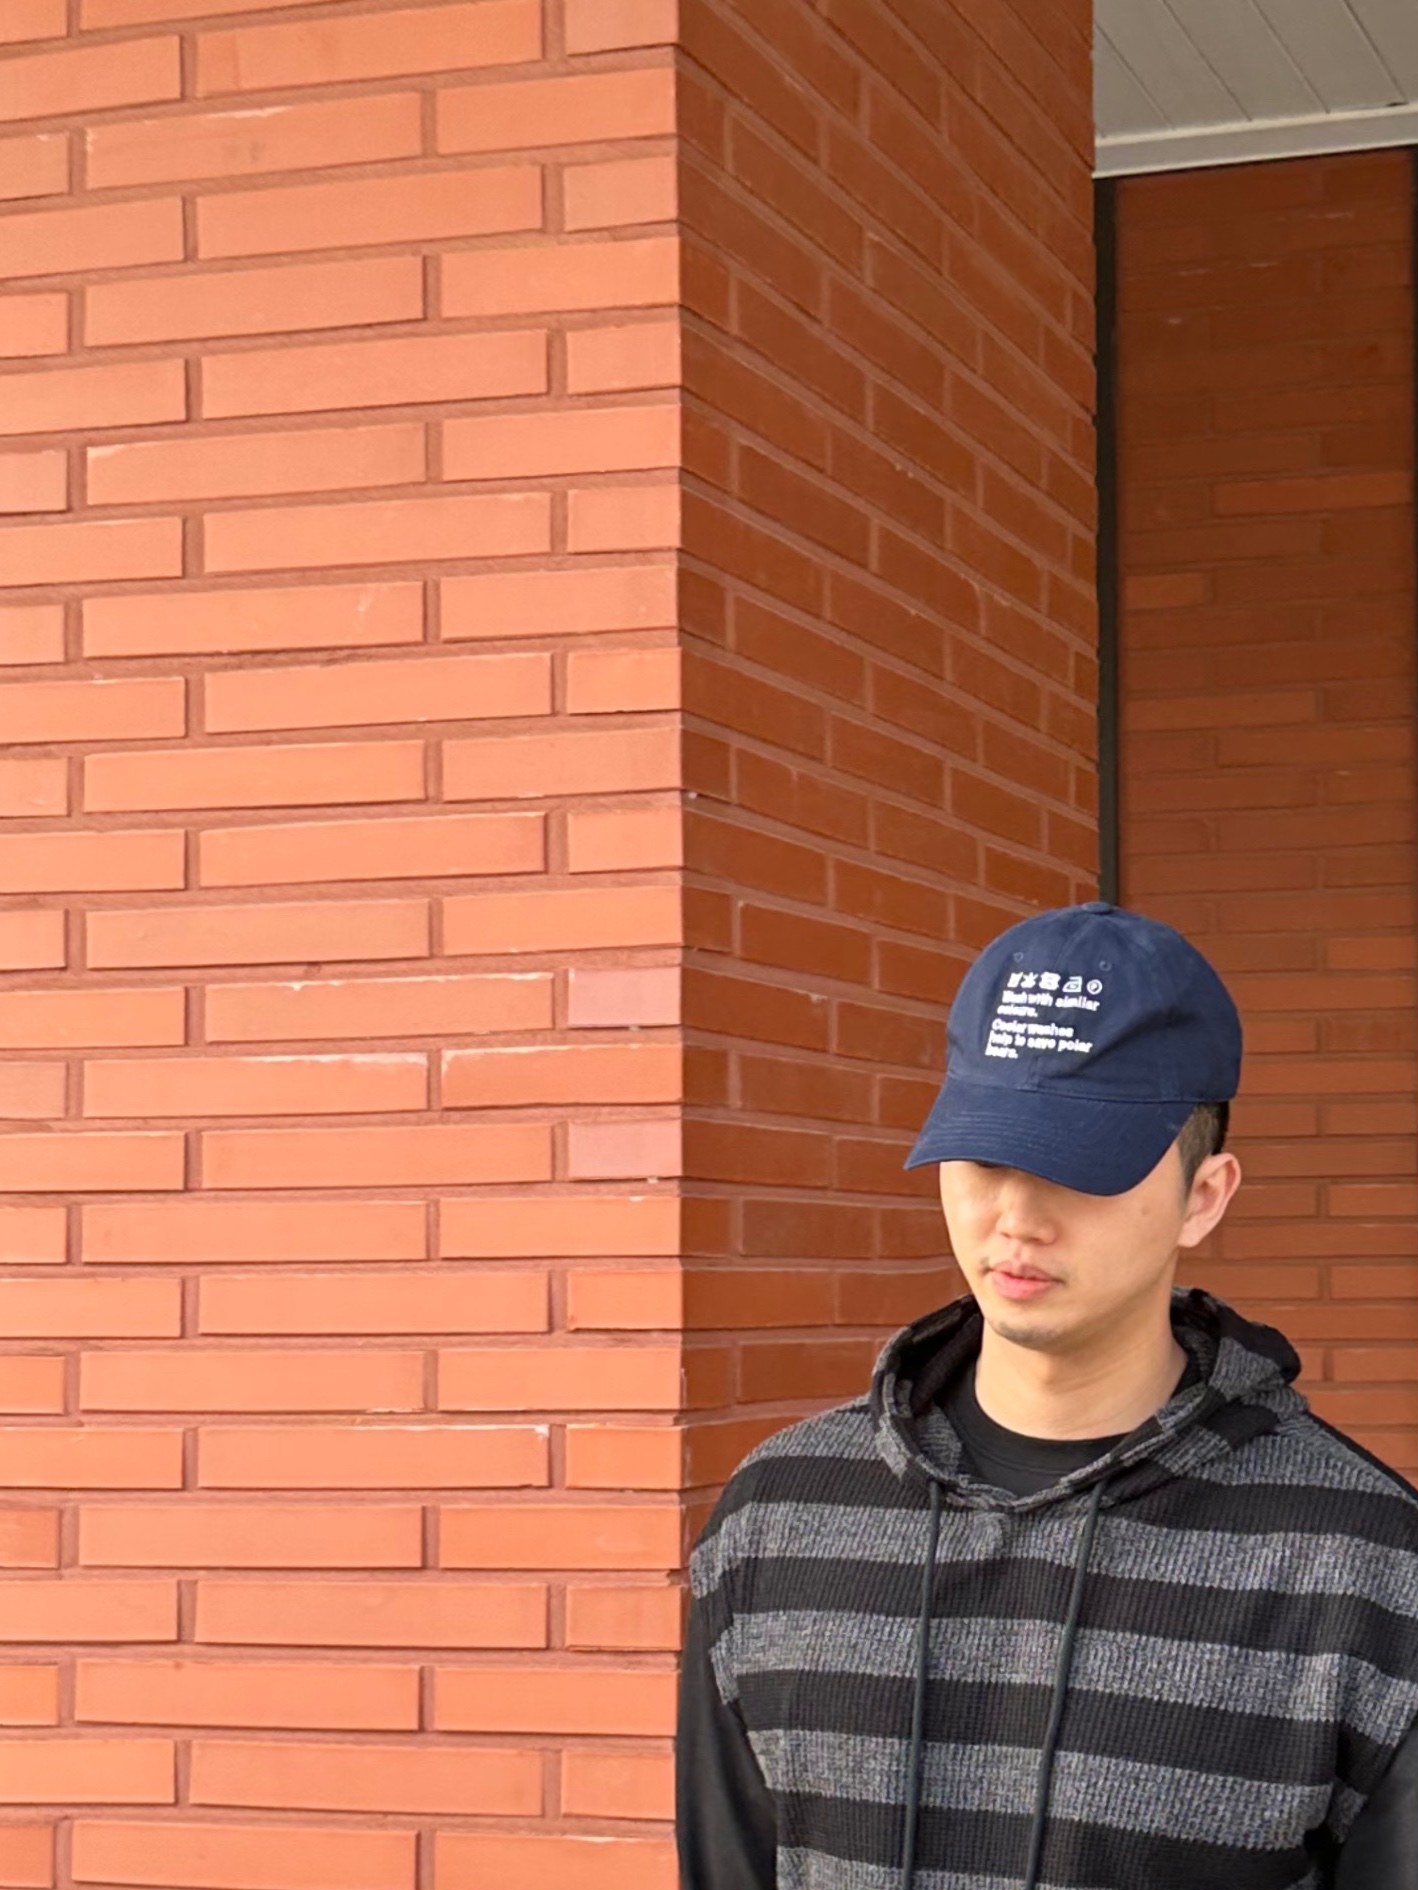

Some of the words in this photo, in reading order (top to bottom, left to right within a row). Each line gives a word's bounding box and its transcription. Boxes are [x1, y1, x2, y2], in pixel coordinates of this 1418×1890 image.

[1028, 993, 1053, 1006] with
[1055, 996, 1100, 1011] similar
[1015, 1033, 1026, 1046] to
[1027, 1037, 1056, 1049] save
[1058, 1039, 1093, 1053] polar
